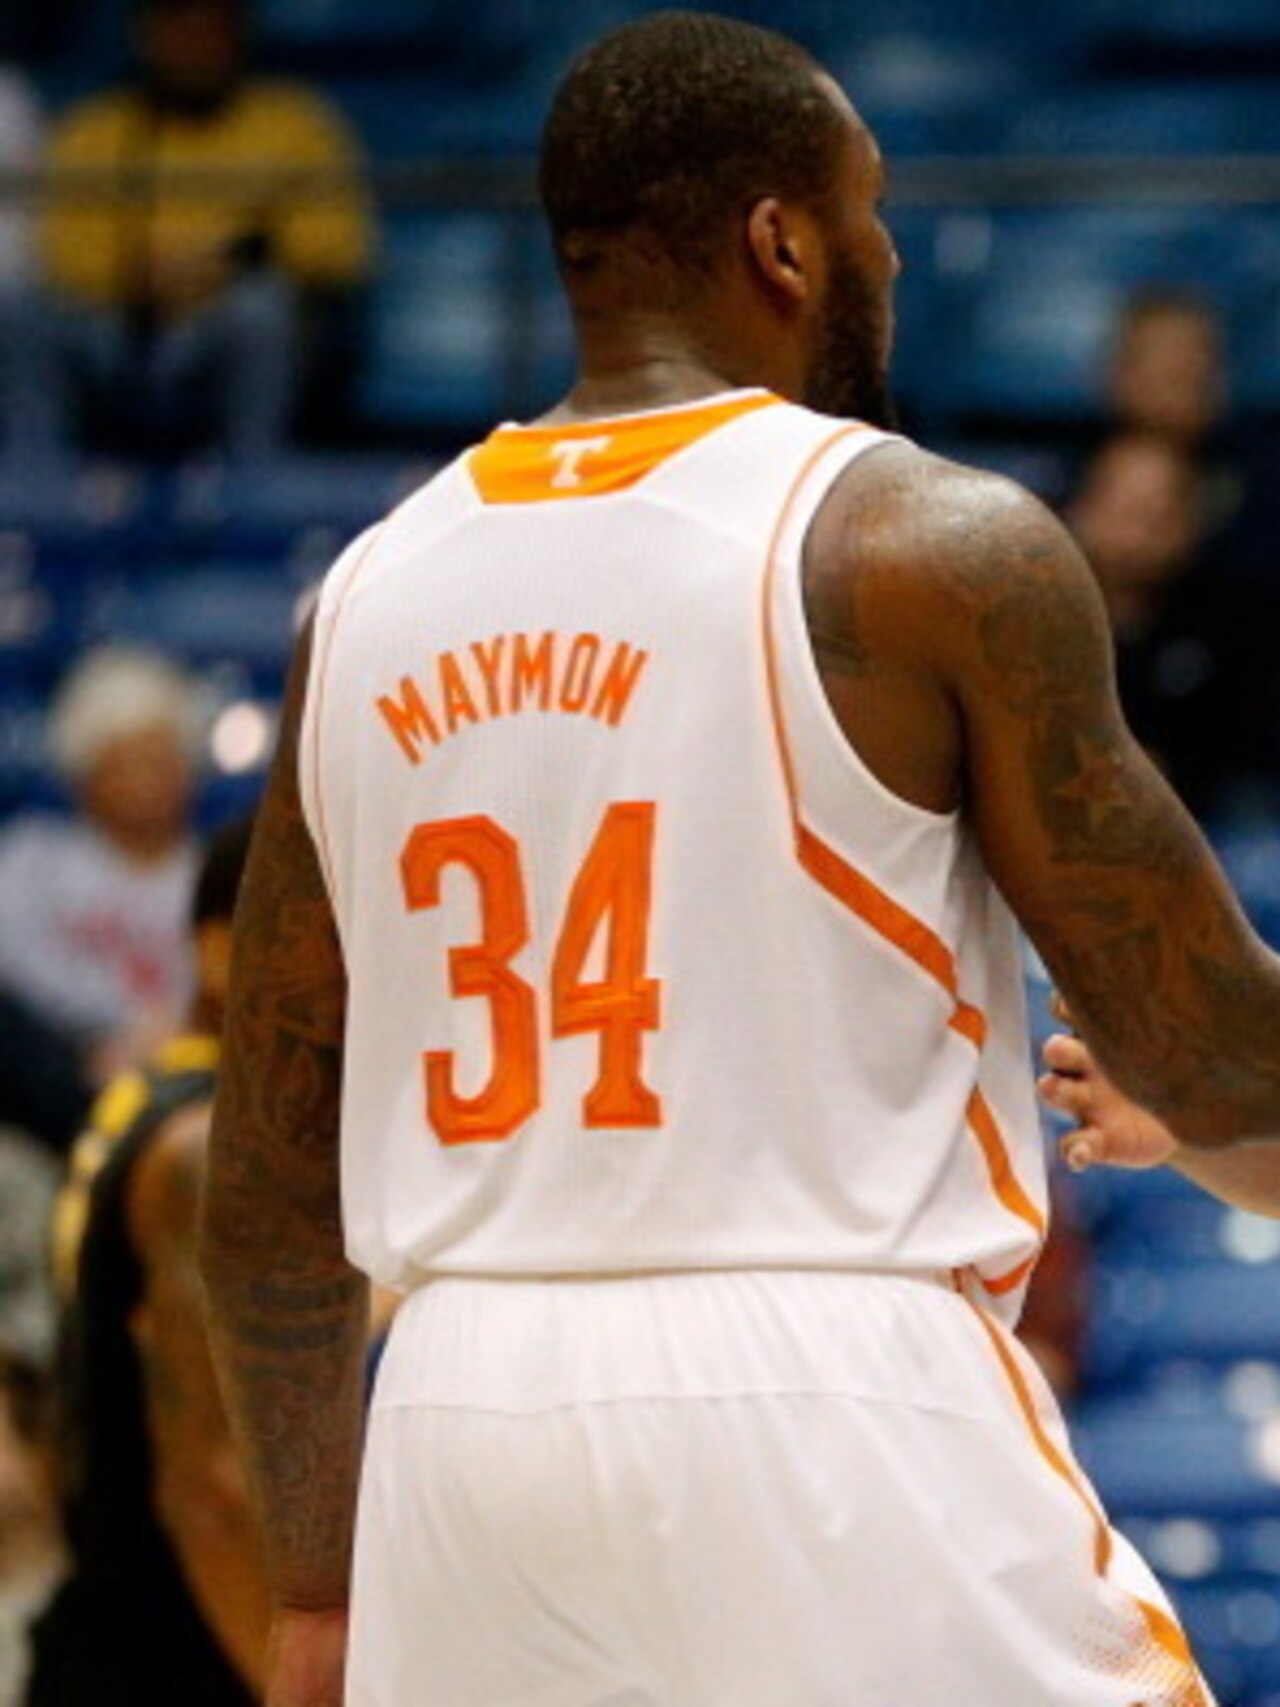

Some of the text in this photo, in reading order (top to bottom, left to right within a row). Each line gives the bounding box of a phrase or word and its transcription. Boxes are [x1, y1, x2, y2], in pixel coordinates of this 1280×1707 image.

[549, 436, 613, 488] T
[375, 629, 648, 767] MAYMON
[400, 800, 662, 1147] 34
